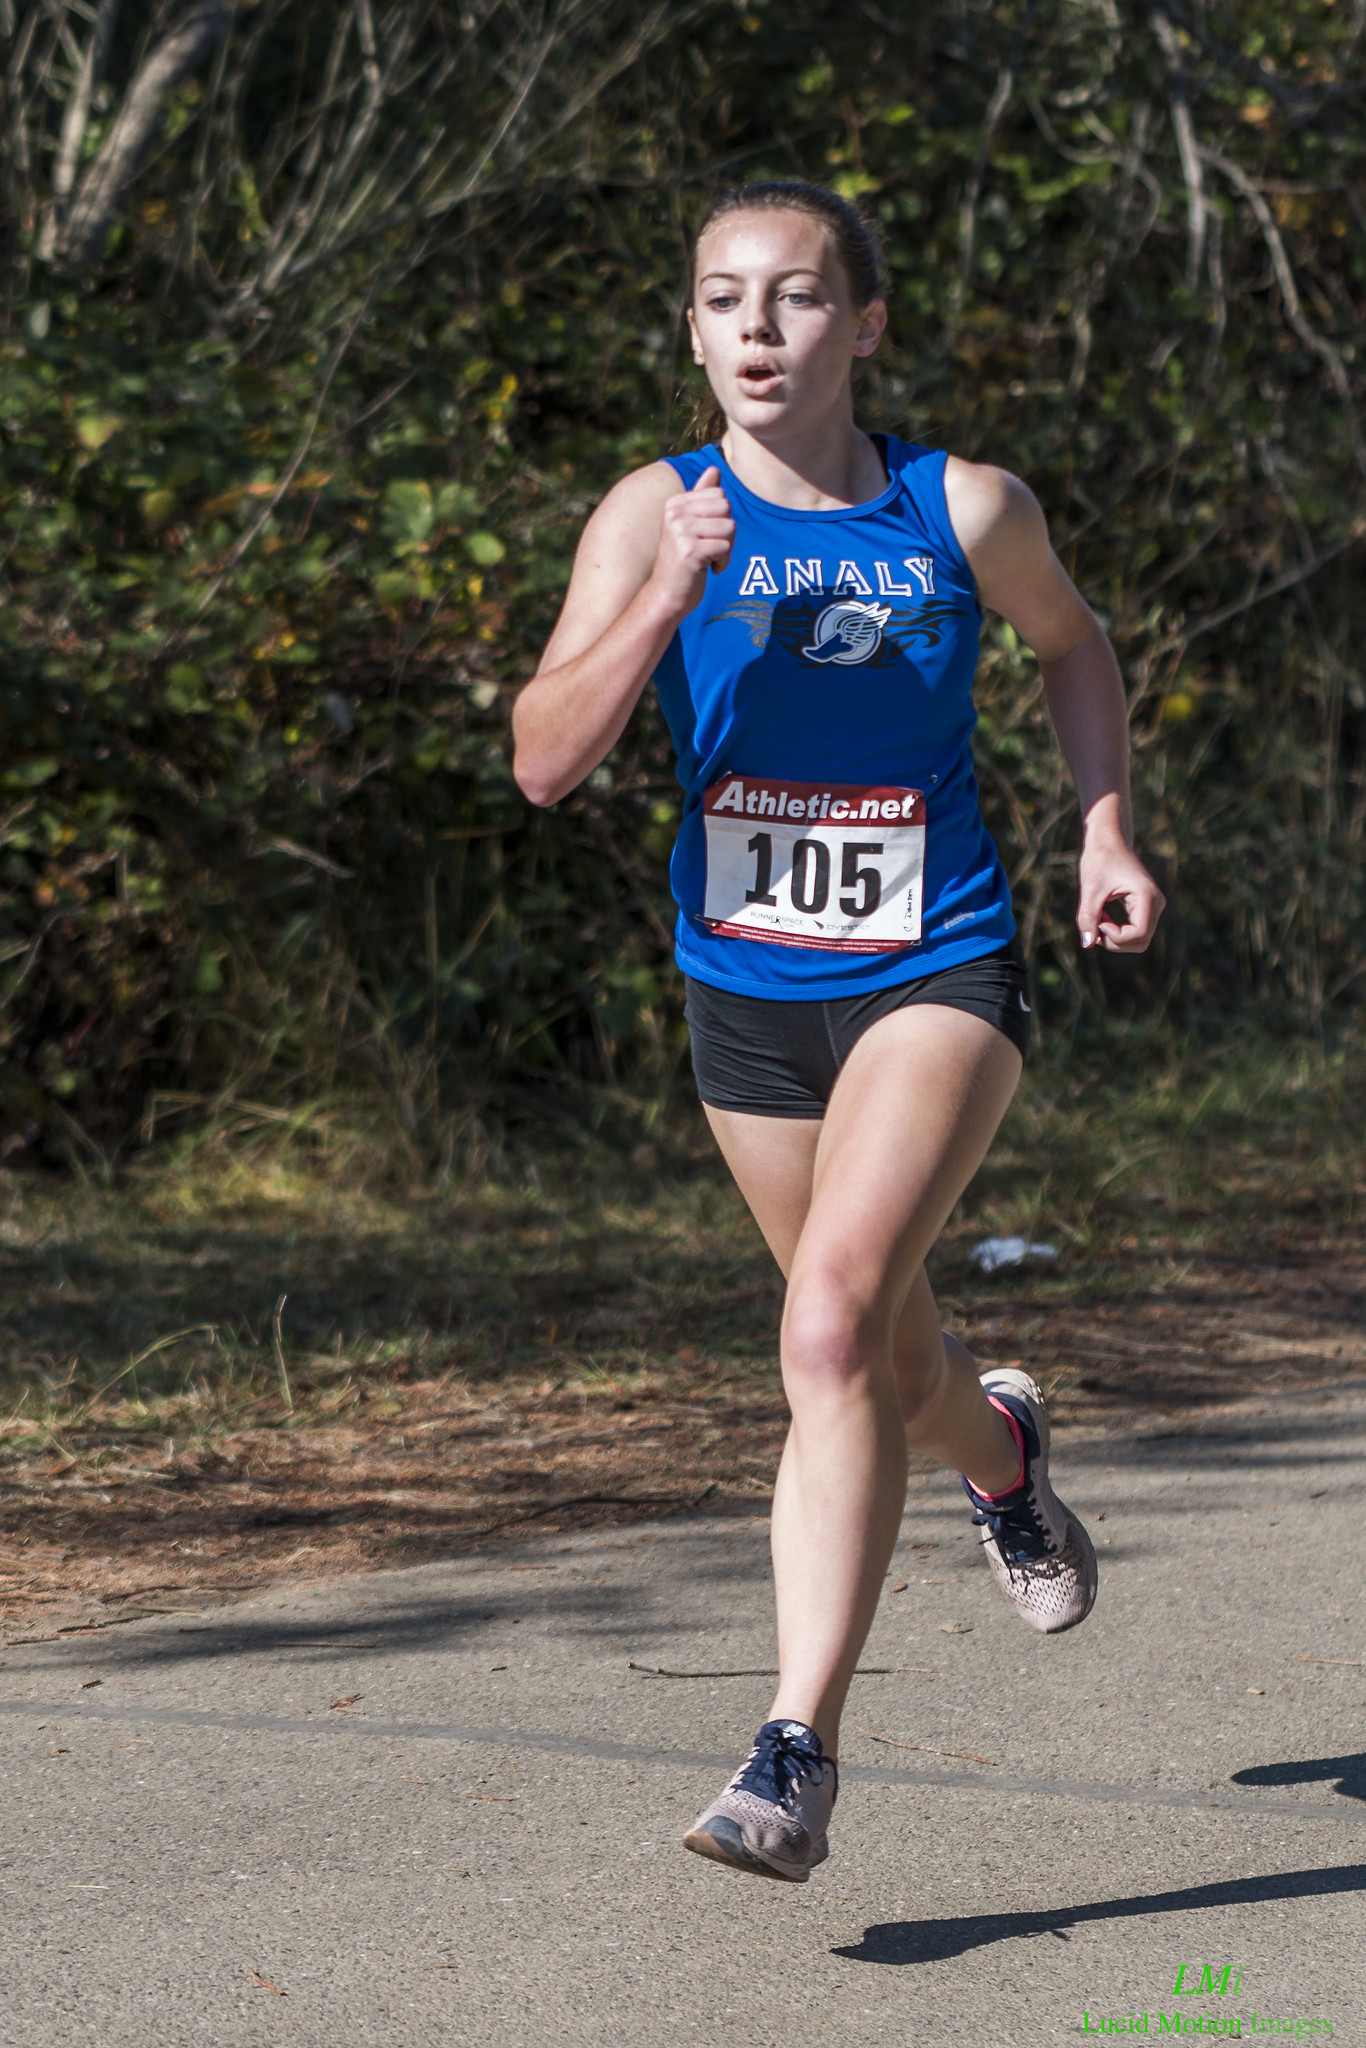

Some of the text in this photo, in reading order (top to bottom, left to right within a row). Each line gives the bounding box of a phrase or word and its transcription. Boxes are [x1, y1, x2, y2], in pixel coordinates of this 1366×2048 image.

[738, 555, 937, 597] ANALY
[712, 780, 919, 820] Athletic.net
[745, 832, 884, 918] 105
